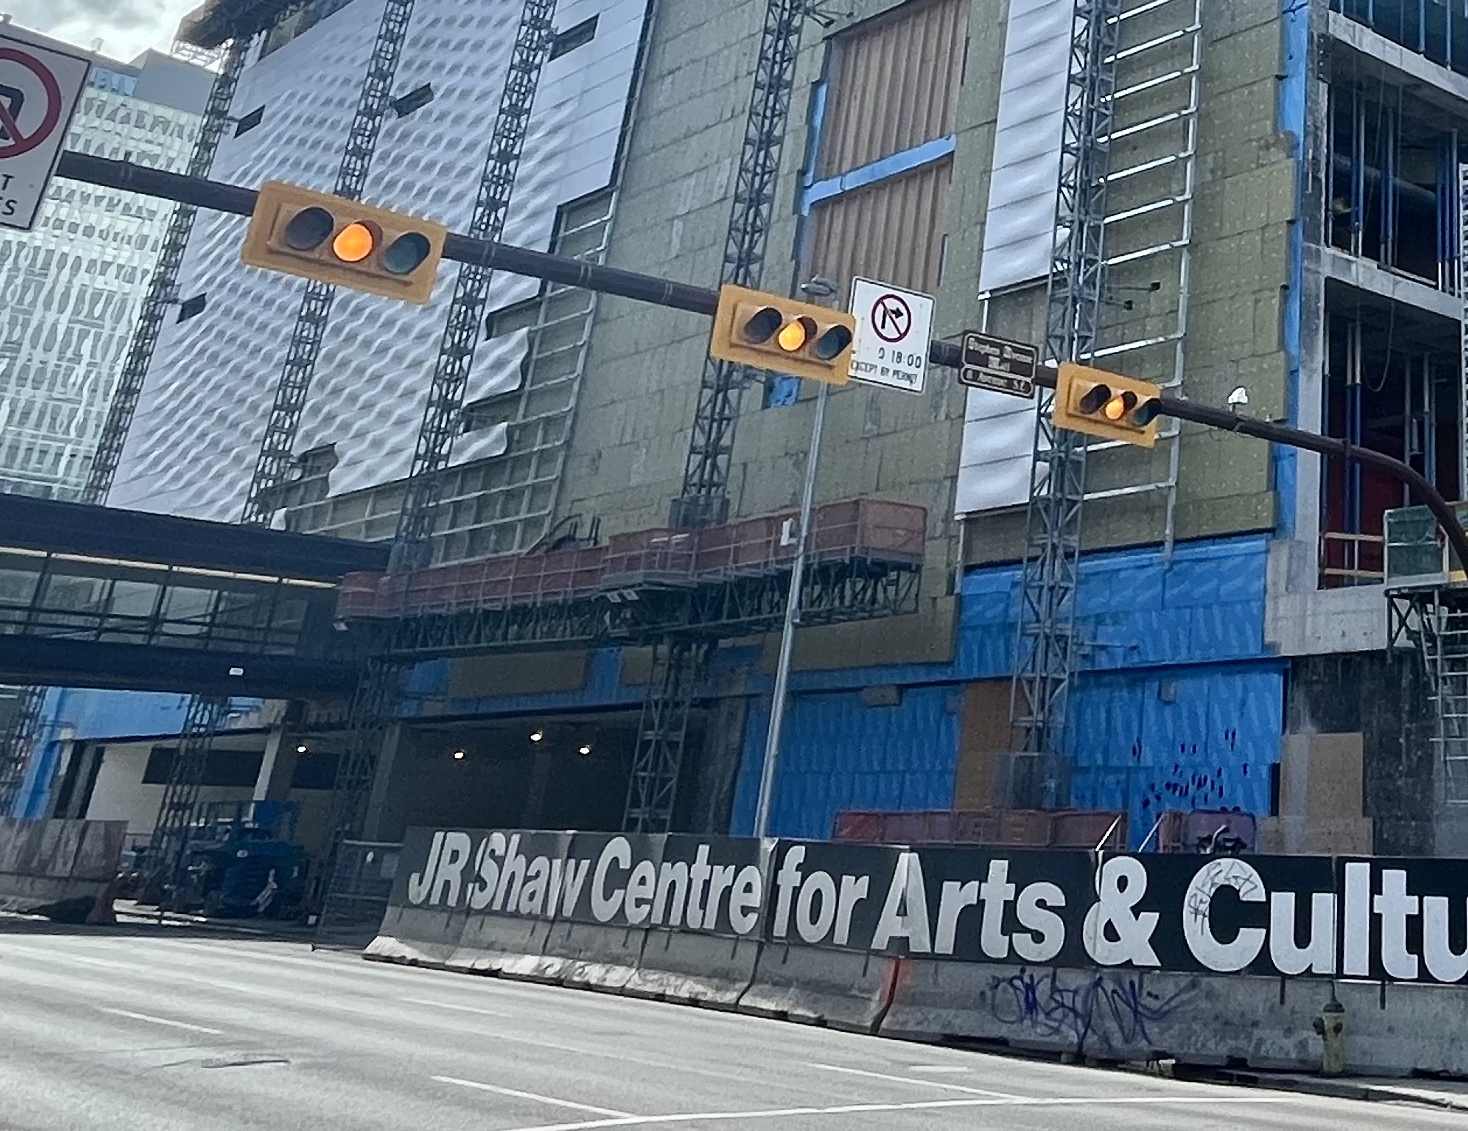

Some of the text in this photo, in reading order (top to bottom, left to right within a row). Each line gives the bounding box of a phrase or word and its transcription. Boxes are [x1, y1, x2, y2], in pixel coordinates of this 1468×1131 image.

[408, 831, 472, 907] JR
[466, 831, 591, 921] Shaw
[591, 836, 763, 935] Centre
[773, 845, 870, 945] for
[871, 851, 1066, 962] Arts
[1082, 855, 1162, 968] &
